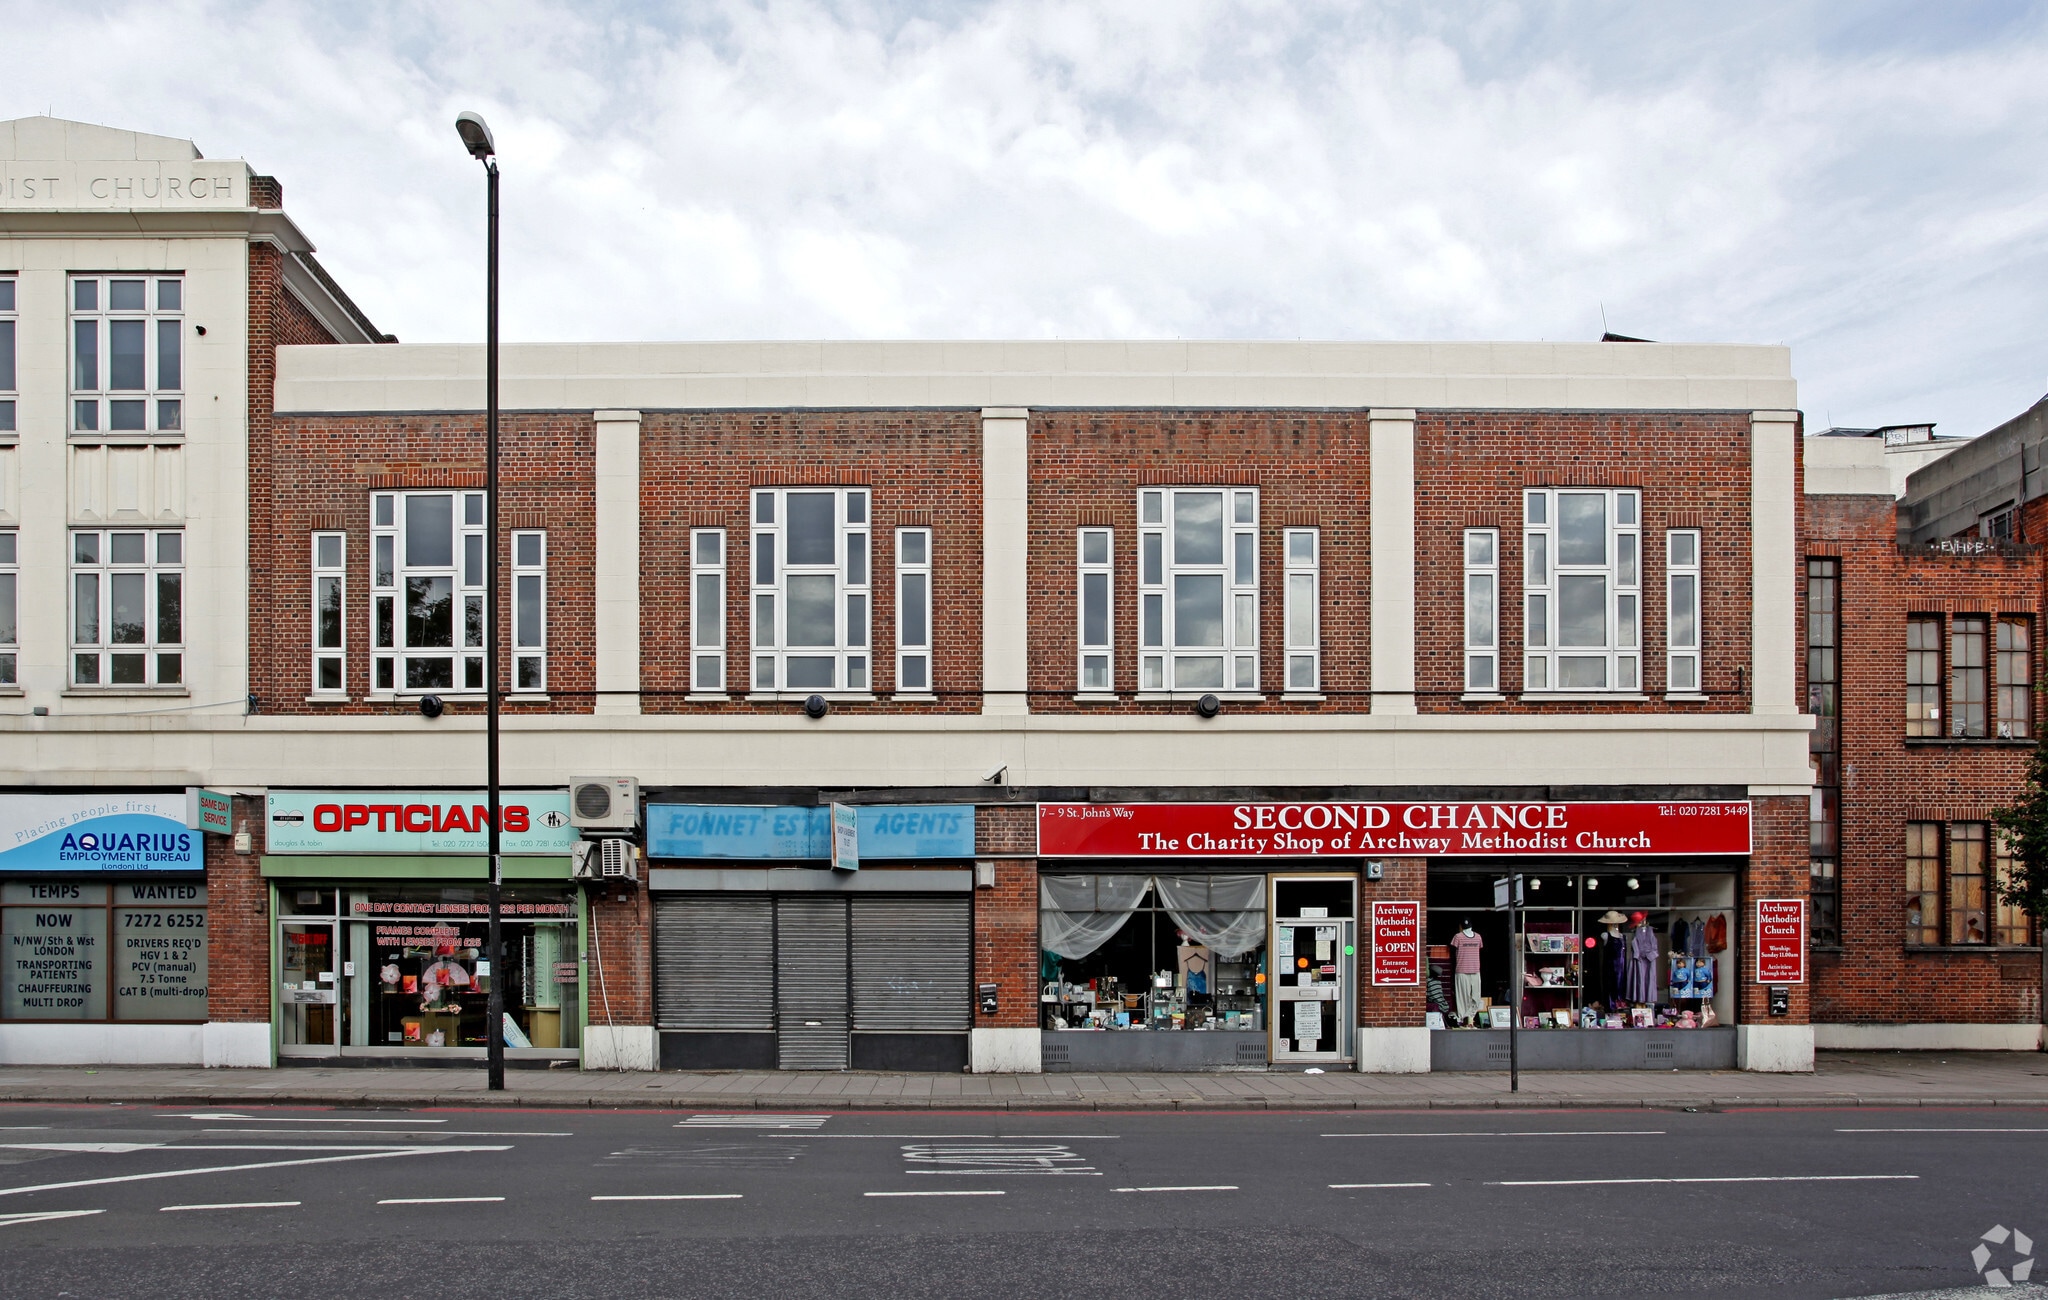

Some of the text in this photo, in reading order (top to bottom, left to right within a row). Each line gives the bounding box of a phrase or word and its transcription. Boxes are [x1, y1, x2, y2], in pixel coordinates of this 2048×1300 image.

[0, 178, 233, 199] IST CHURCH
[201, 797, 230, 812] SAME DAY
[269, 797, 275, 805] 3
[1040, 808, 1047, 817] 7
[1058, 808, 1064, 818] 9
[1066, 807, 1080, 817] St.
[1112, 808, 1134, 819] Way
[1658, 805, 1748, 816] Tel: 020 7281 5449
[15, 816, 68, 843] Placing
[72, 802, 119, 822] people
[126, 801, 158, 813] first
[203, 812, 227, 826] SERVICE
[313, 804, 531, 833] OPTICIANS
[1233, 805, 1568, 830] SECOND CHANCE
[668, 813, 761, 836] FONNET
[772, 814, 832, 836] ESTA
[874, 812, 963, 835] AGENTS
[60, 832, 191, 852] AQUARIUS
[1138, 831, 1651, 855] The Charity Shop of Archway Methodist Church
[60, 852, 191, 862] EMPLOYMENT BUREAU
[29, 885, 197, 899] TEMPS WANTED
[354, 903, 374, 913] ONE
[374, 903, 393, 913] DAY
[393, 903, 435, 913] CONTACT
[436, 904, 469, 914] LENSES
[470, 904, 490, 914] FRO
[517, 904, 534, 914] PER
[535, 904, 569, 914] MONTH
[1377, 905, 1413, 916] Archway
[1762, 903, 1798, 914] Archway
[36, 914, 72, 927] NOW
[125, 914, 204, 927] 7272 6252
[1375, 917, 1415, 926] Methodist
[1760, 914, 1800, 923] Methodist
[376, 926, 460, 936] FRAMES COMPLETE
[1380, 927, 1411, 937] Church
[1764, 925, 1795, 934] Church
[67, 936, 74, 945] &
[77, 936, 95, 945] Wst
[127, 939, 201, 949] DRIVERS REQ'D
[376, 937, 400, 946] WITH
[401, 937, 435, 946] LENSES
[436, 938, 462, 946] FROM
[34, 947, 75, 955] LONDON
[1375, 942, 1415, 953] is OPEN
[140, 951, 188, 960] HGV 1 & 2
[1761, 951, 1779, 959] Sunday
[16, 960, 92, 969] TRANSPORTING
[132, 962, 196, 973] PCV (manual)
[30, 970, 78, 979] PATIENTS
[140, 975, 187, 983] 7.5 Tonne
[18, 984, 92, 993] CHAUFFEURING
[120, 987, 208, 998] CAT B (multi-drop)
[23, 998, 84, 1007] MULTI DROP
